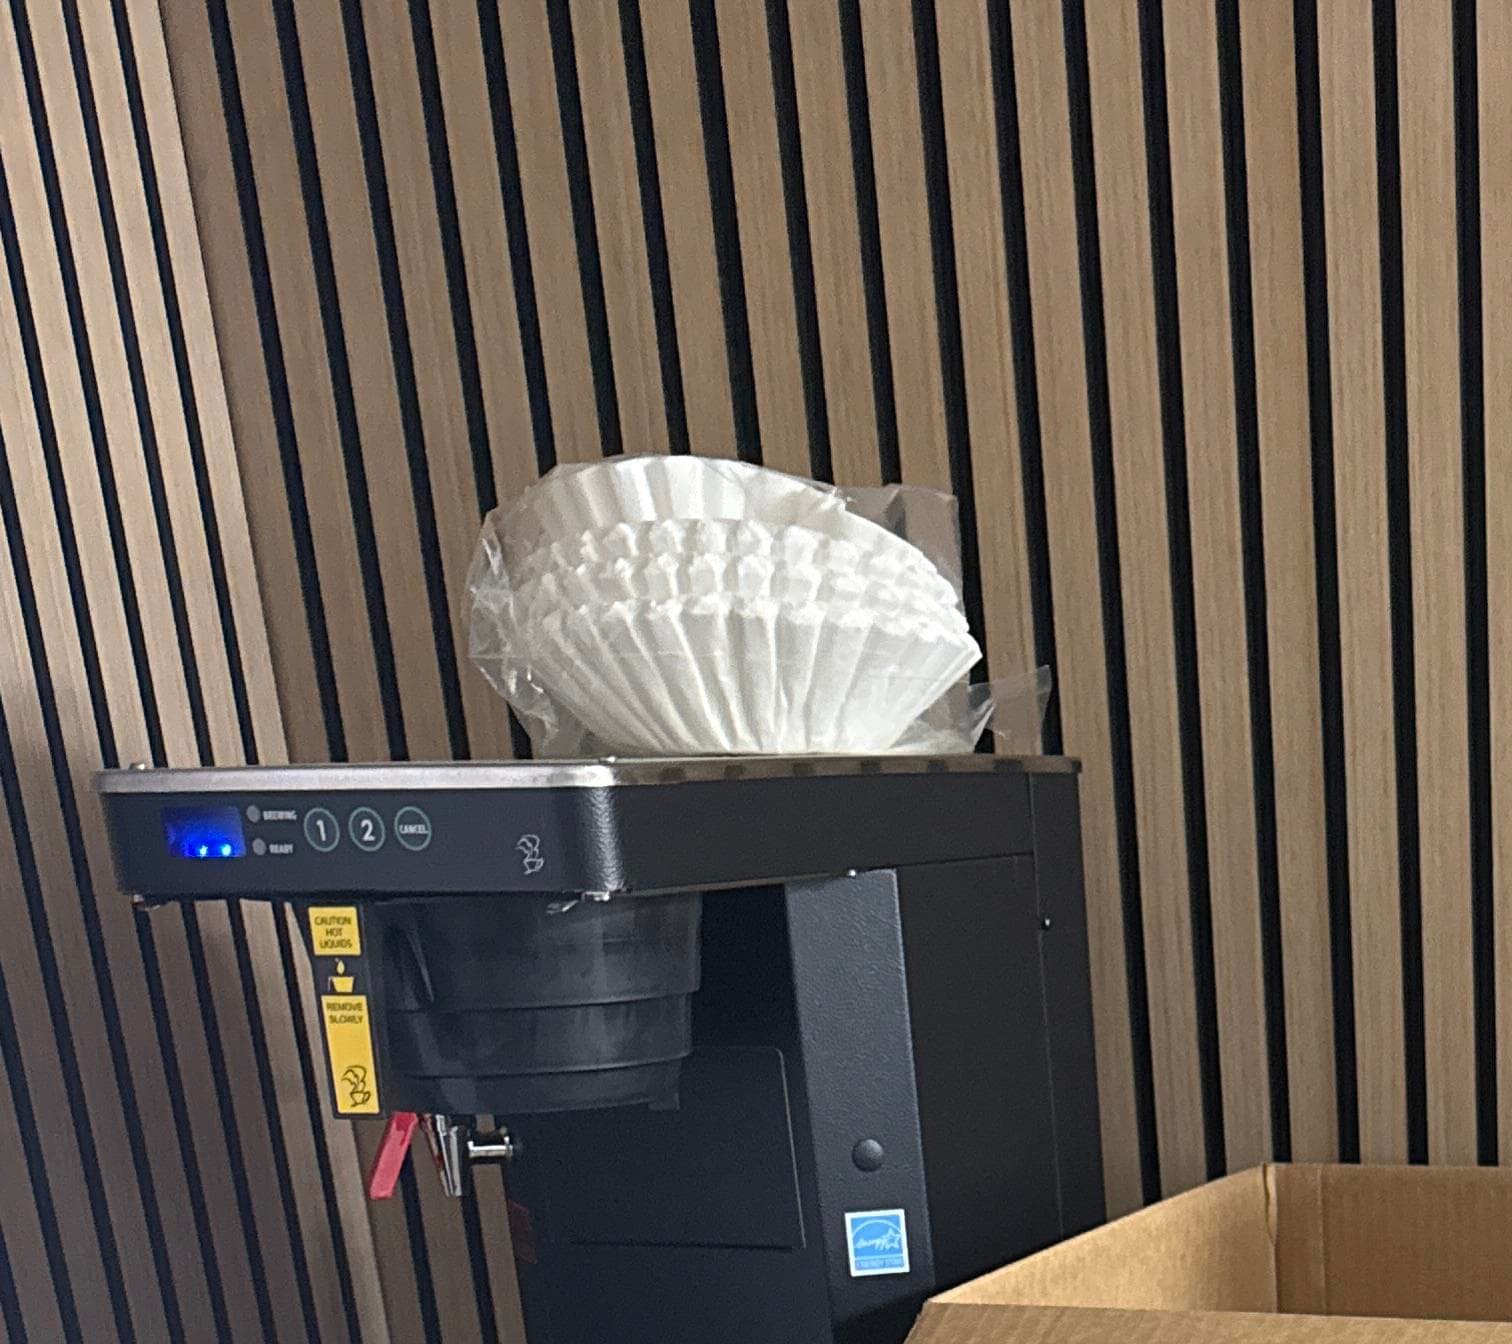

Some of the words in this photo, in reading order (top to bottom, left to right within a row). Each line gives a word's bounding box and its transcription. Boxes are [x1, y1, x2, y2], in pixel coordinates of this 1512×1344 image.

[316, 820, 327, 841] 1
[361, 819, 375, 841] 2
[314, 916, 351, 925] CAUTION
[326, 928, 342, 936] HOT
[320, 939, 352, 949] LIQUIDS
[327, 1003, 362, 1011] REMOVE
[329, 1015, 363, 1024] SLOWLY
